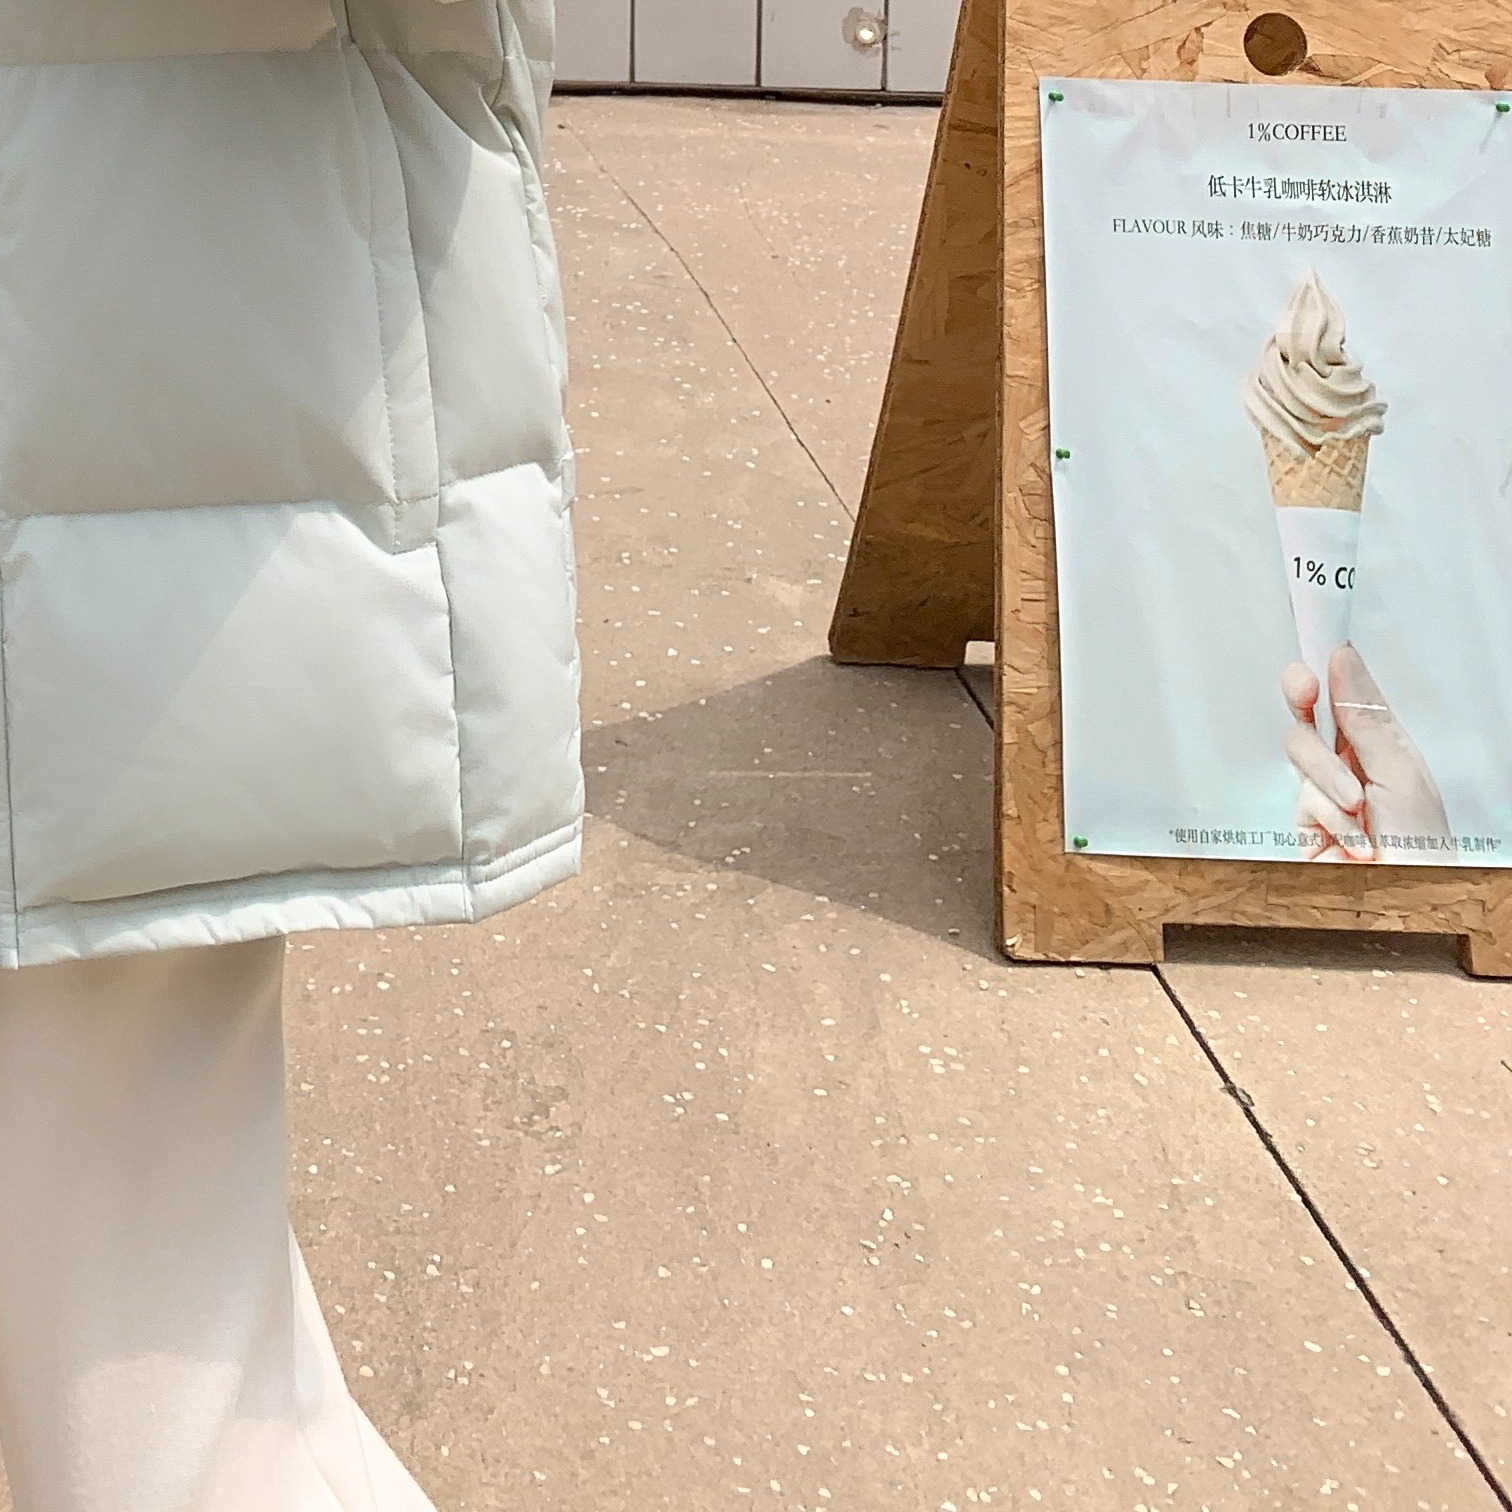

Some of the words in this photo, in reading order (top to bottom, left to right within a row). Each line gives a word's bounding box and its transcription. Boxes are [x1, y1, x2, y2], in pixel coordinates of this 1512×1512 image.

[1248, 122, 1347, 142] 1%COFFEE
[1207, 174, 1393, 204] 低卡牛乳咖啡软冰淇淋
[1113, 218, 1186, 235] FLAVOUR
[1293, 556, 1327, 586] 1%
